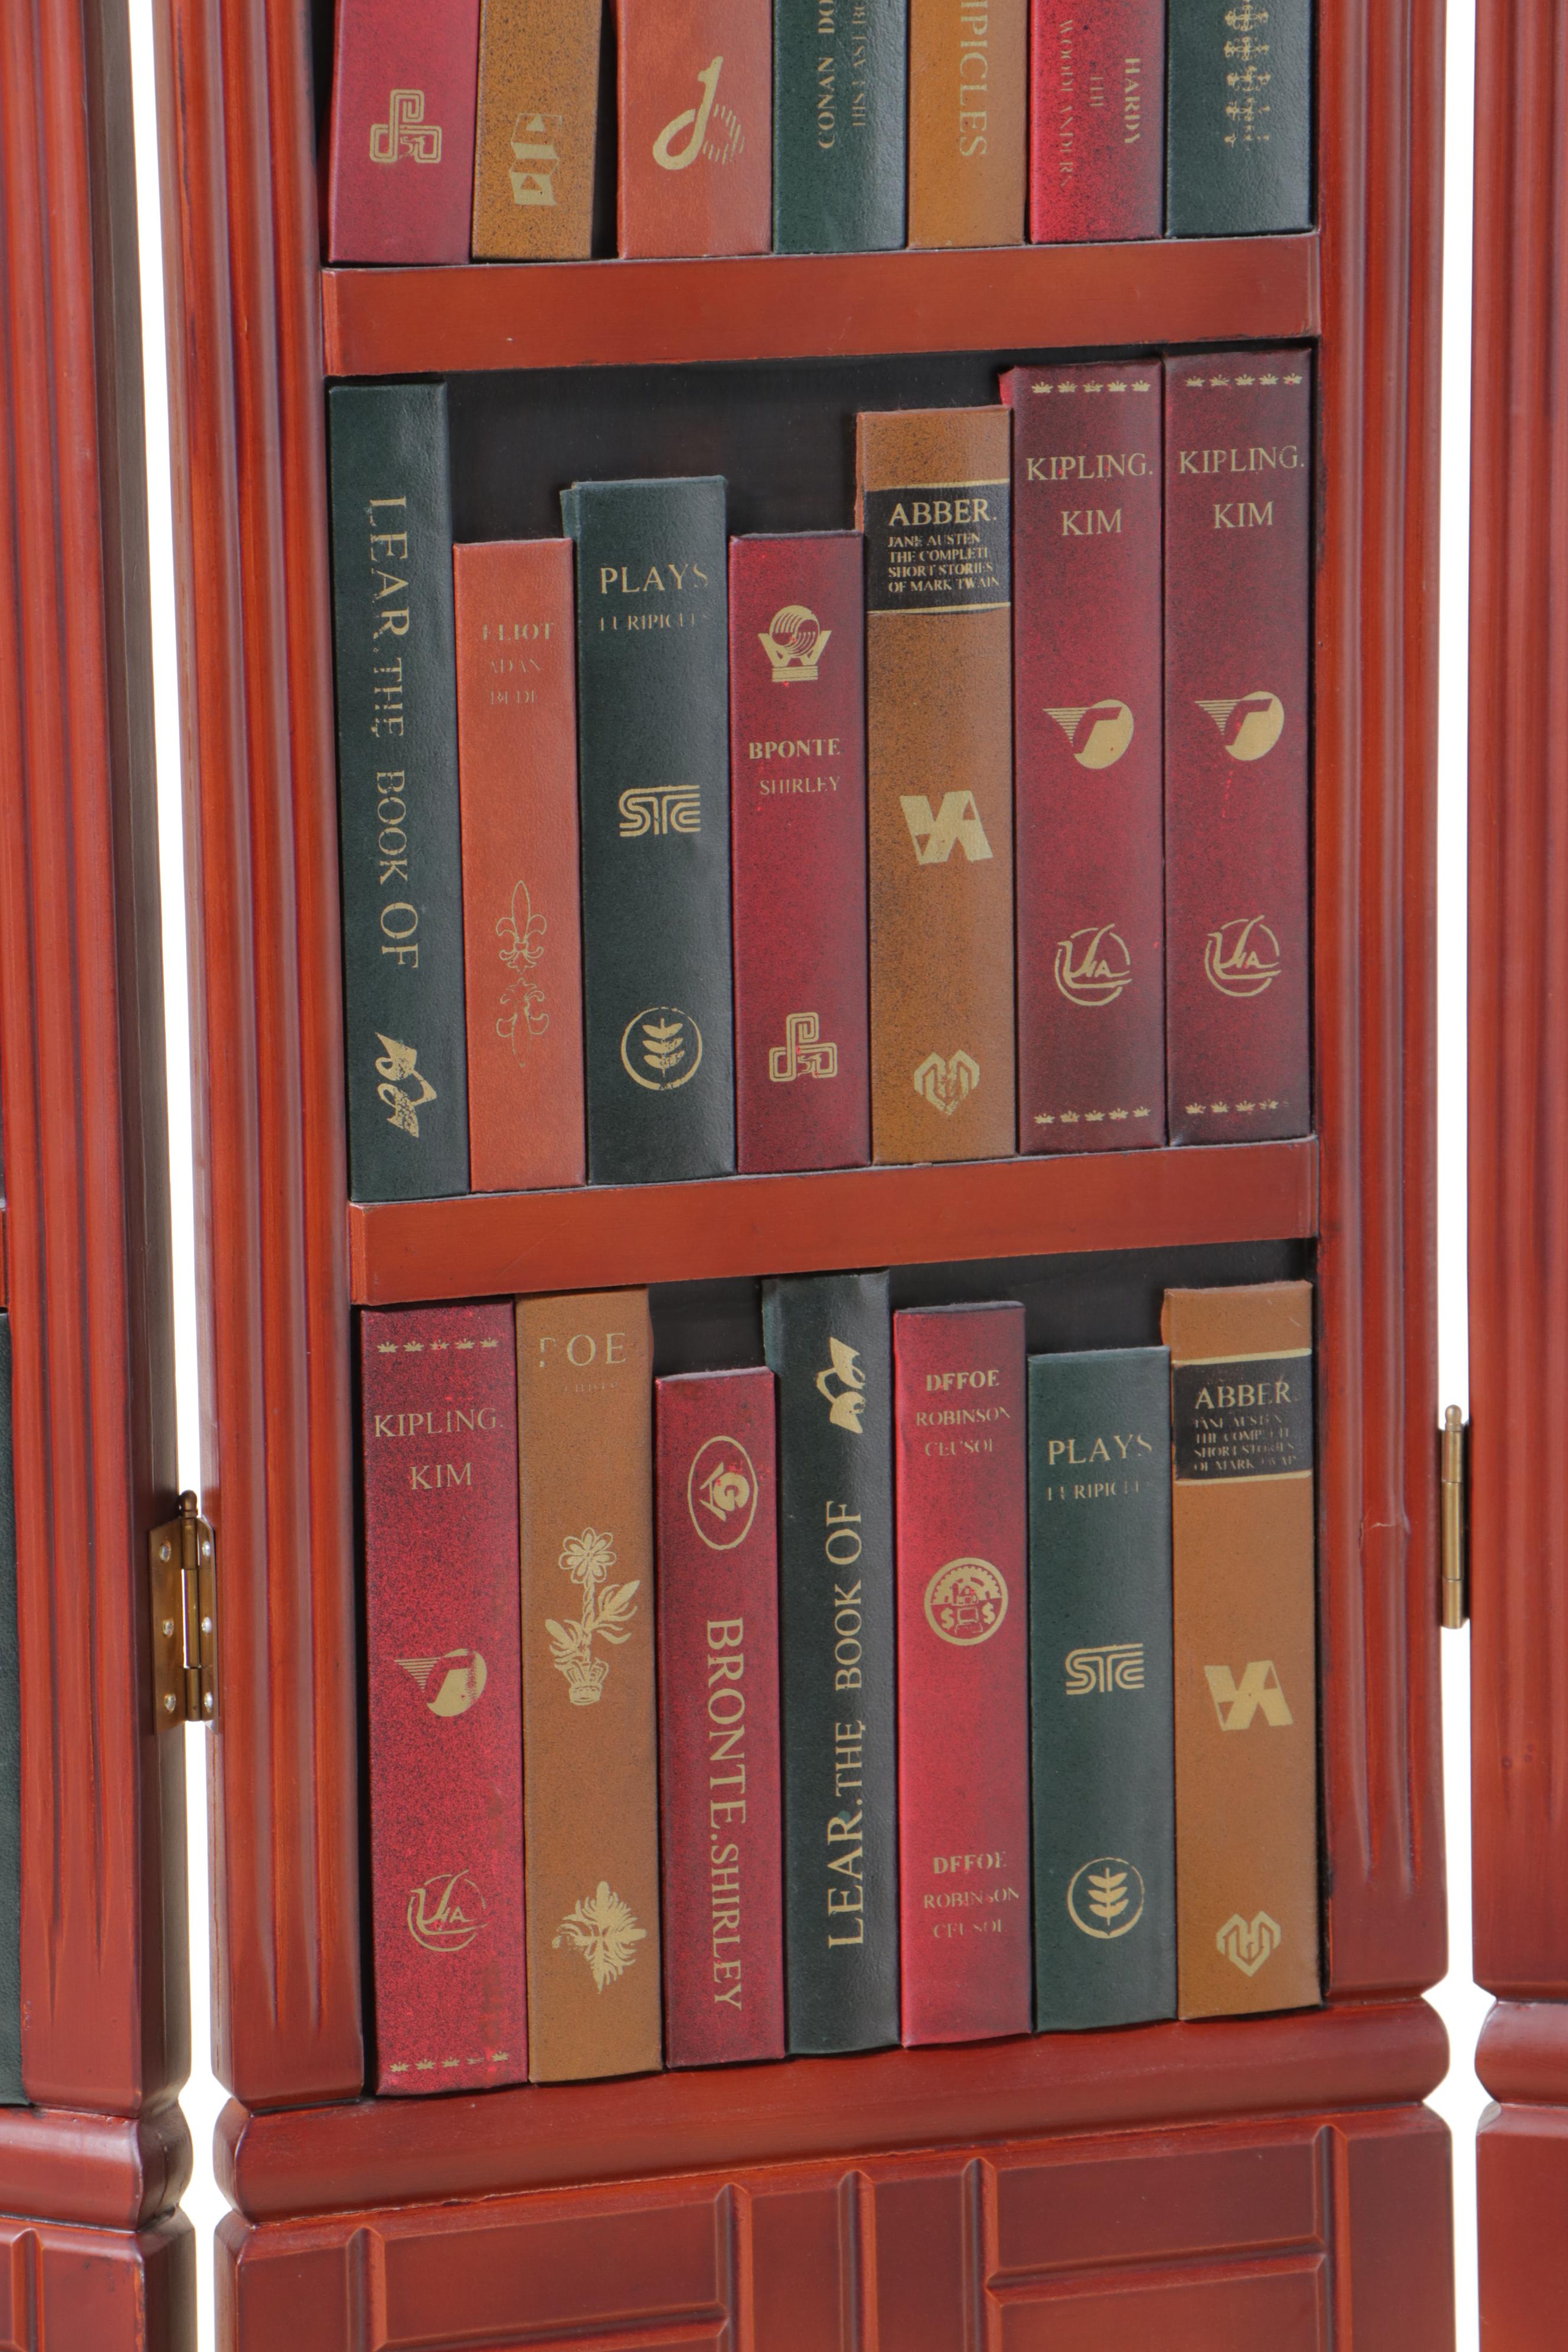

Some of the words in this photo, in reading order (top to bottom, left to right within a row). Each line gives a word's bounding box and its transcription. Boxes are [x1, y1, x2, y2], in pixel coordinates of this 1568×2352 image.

[817, 57, 835, 149] CONAN
[1060, 508, 1123, 537] KIM
[1213, 500, 1274, 530] KIM
[600, 563, 708, 594] PLAYS
[887, 581, 907, 593] OF
[910, 579, 953, 592] MARK
[376, 770, 408, 886] BOOK
[380, 901, 419, 969] OF
[1047, 1433, 1152, 1465] PLAYS
[410, 1462, 472, 1490] KIM
[825, 1500, 863, 1566] OF
[834, 1579, 863, 1691] BOOK
